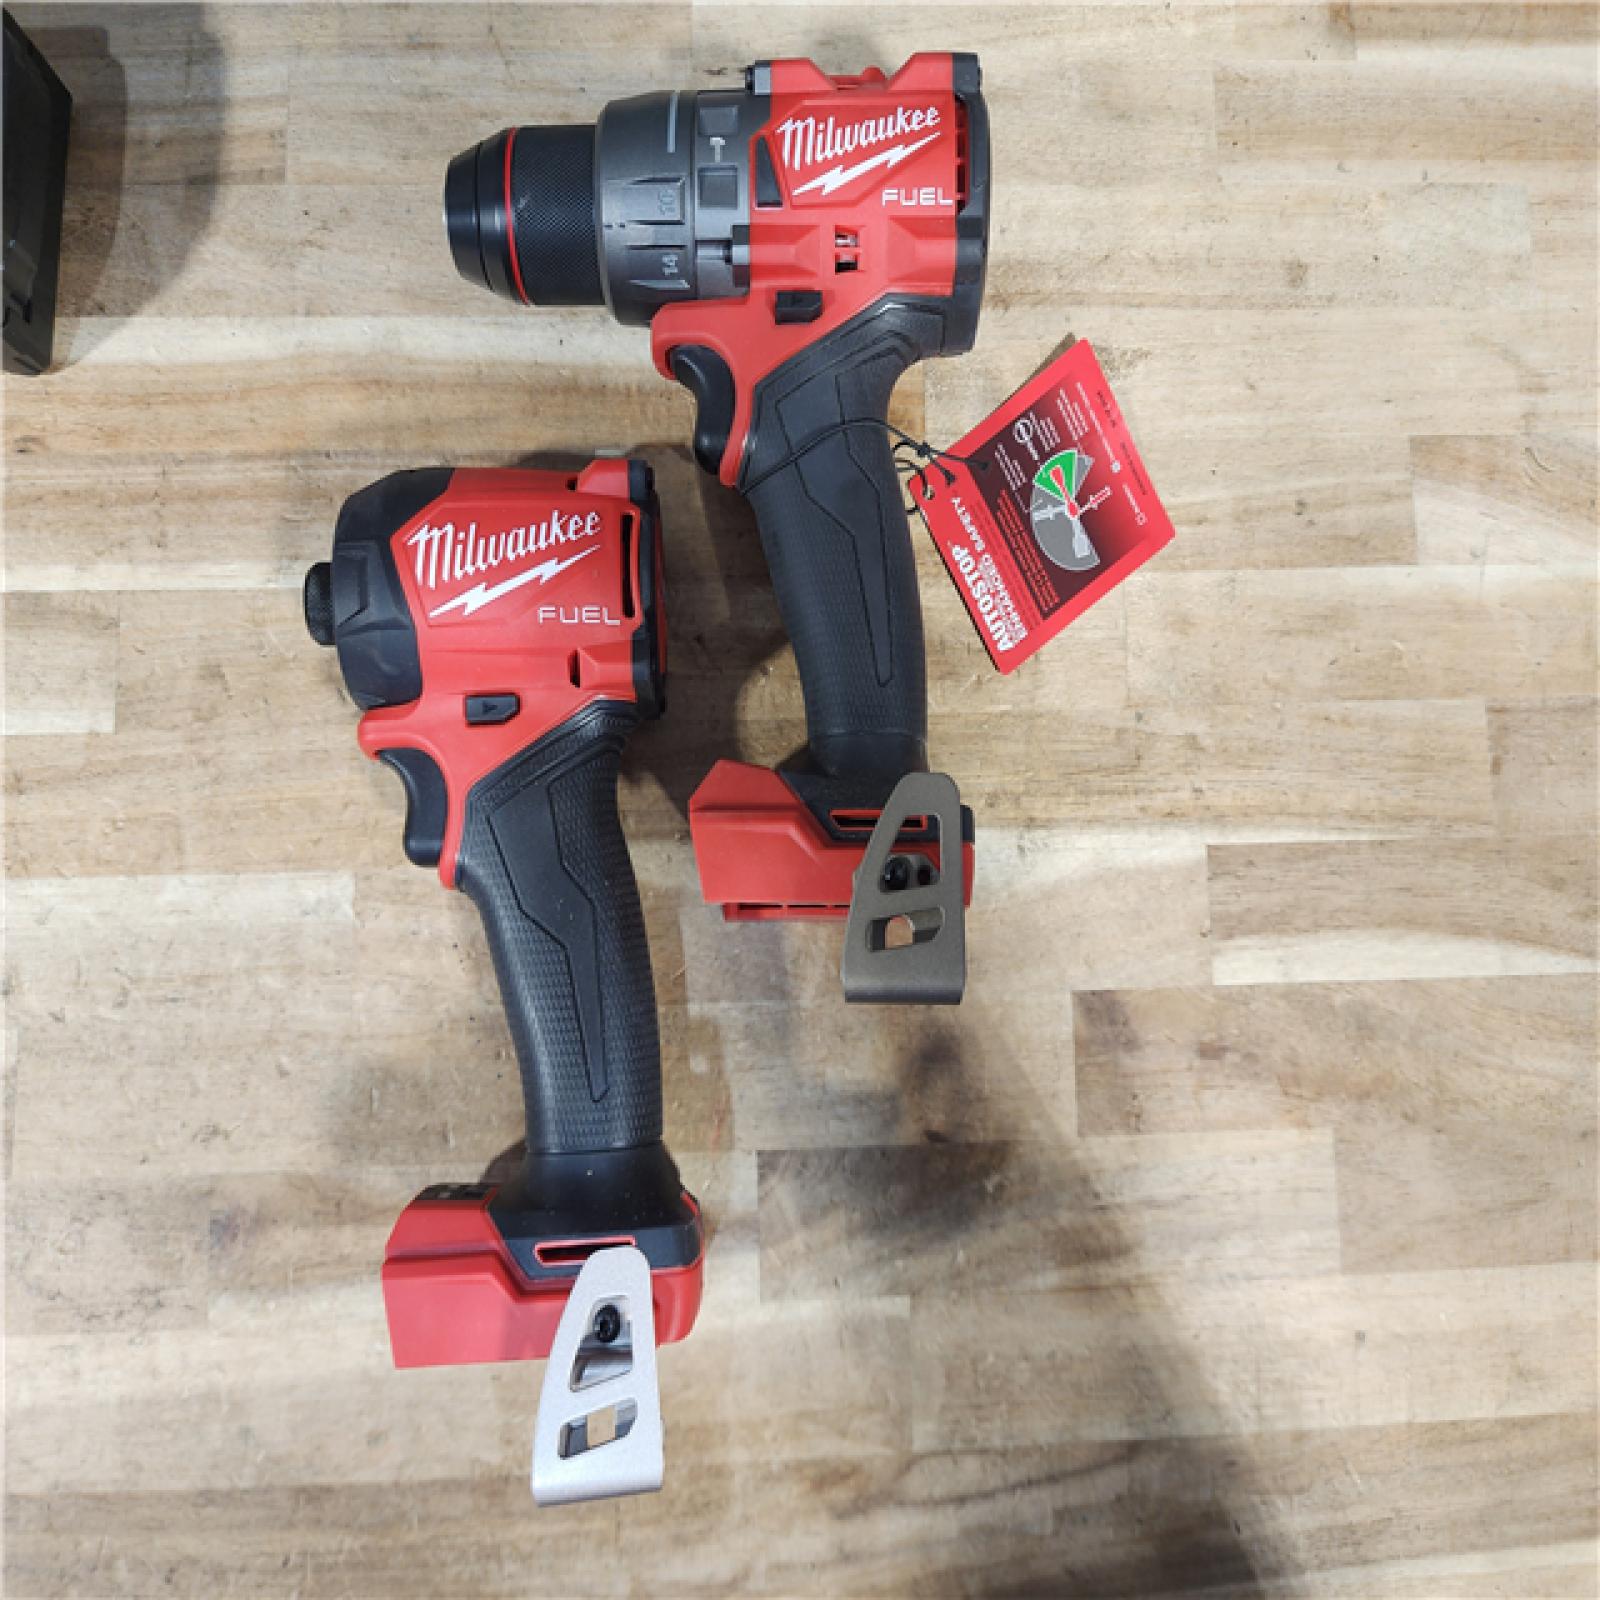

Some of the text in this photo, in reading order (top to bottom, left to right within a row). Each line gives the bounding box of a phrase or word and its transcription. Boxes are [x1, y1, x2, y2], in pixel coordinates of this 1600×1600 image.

[777, 106, 941, 171] Milwaukee
[881, 187, 954, 206] FUEL
[662, 254, 679, 276] 14
[407, 510, 601, 590] Milwaukee
[538, 606, 621, 626] FUEL
[952, 545, 1014, 652] AUTOSTOP
